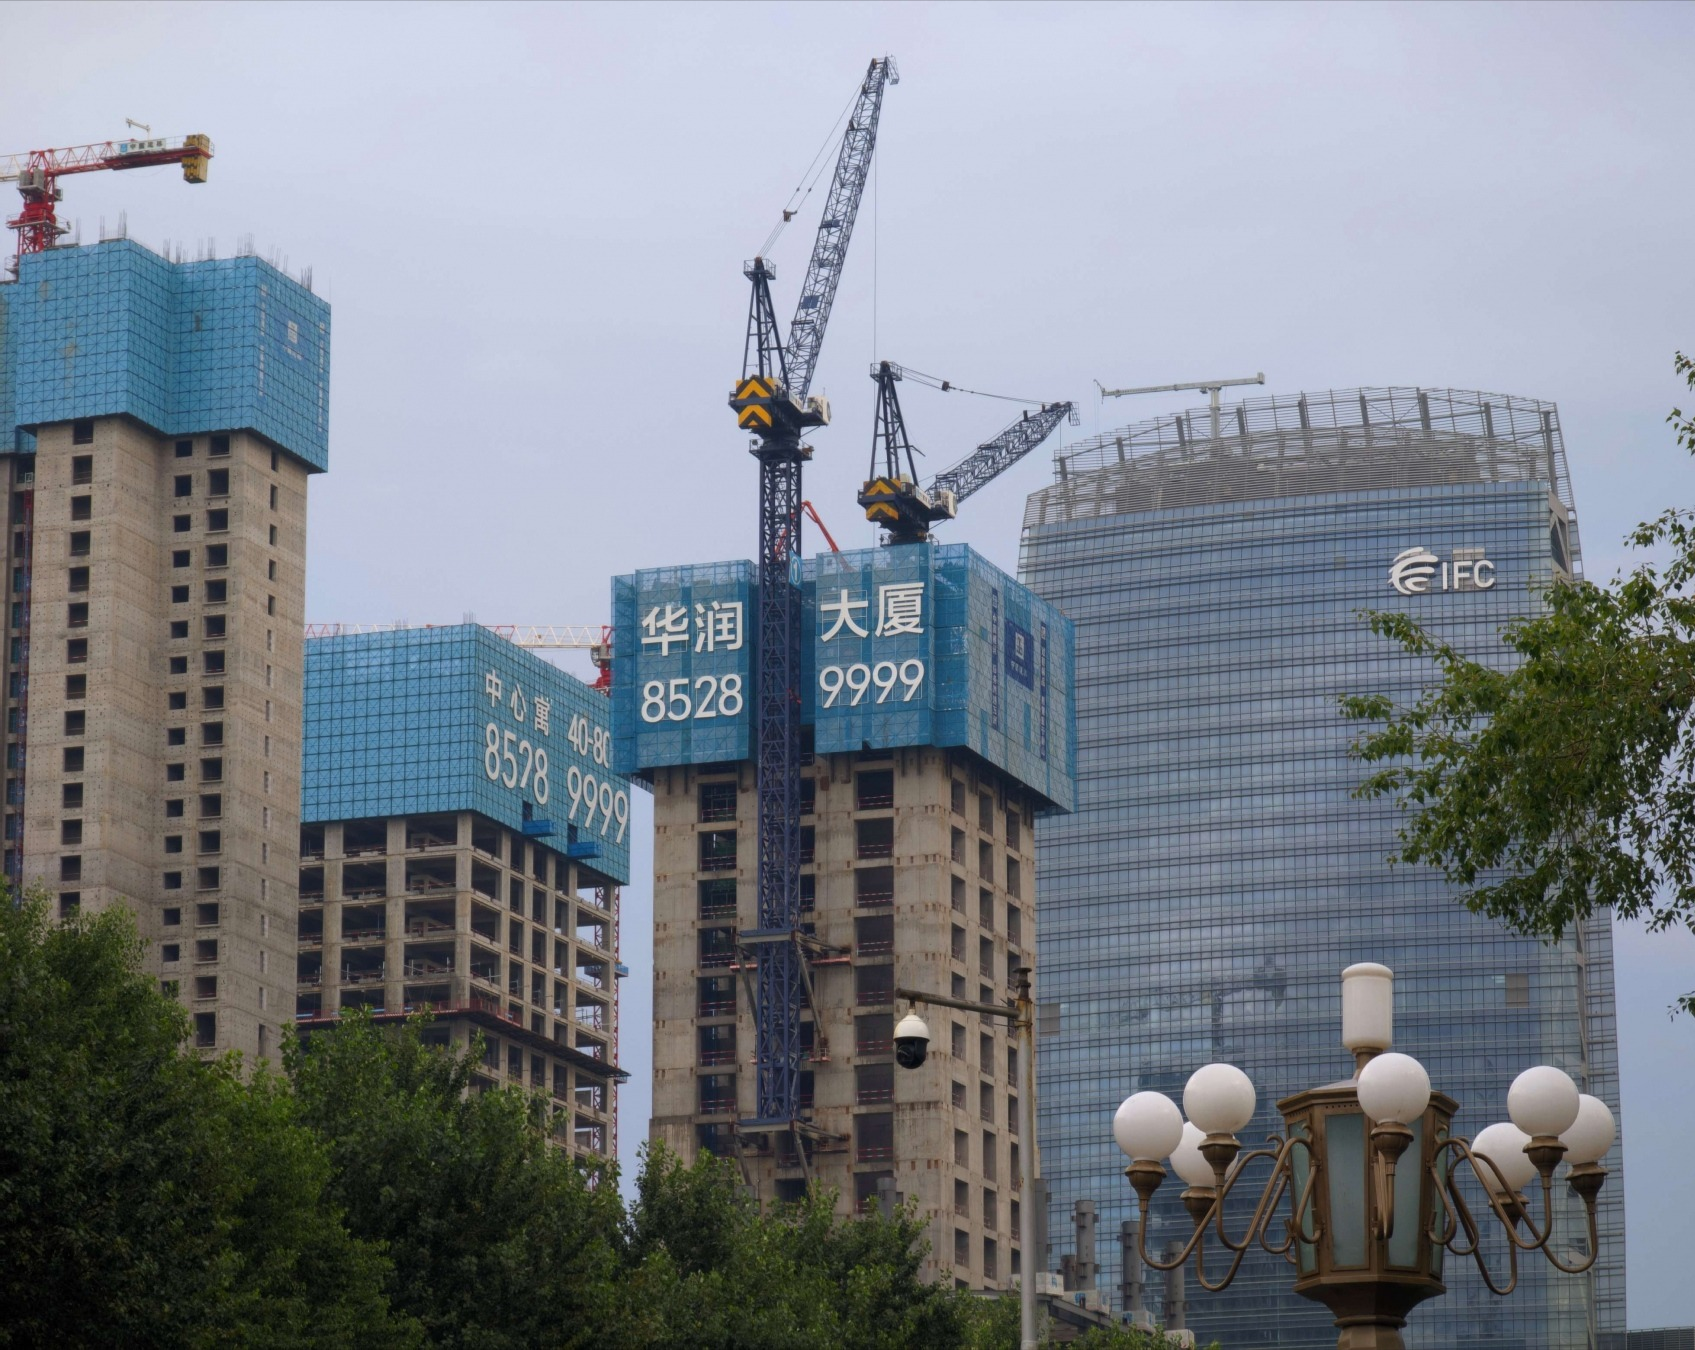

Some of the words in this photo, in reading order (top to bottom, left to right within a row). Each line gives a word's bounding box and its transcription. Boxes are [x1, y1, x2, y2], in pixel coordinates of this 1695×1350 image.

[1442, 559, 1495, 590] IFC
[641, 600, 743, 657] 华润
[820, 582, 925, 642] 大厦
[641, 673, 743, 723] 8528
[819, 659, 925, 708] 9999
[567, 765, 628, 844] 9999
